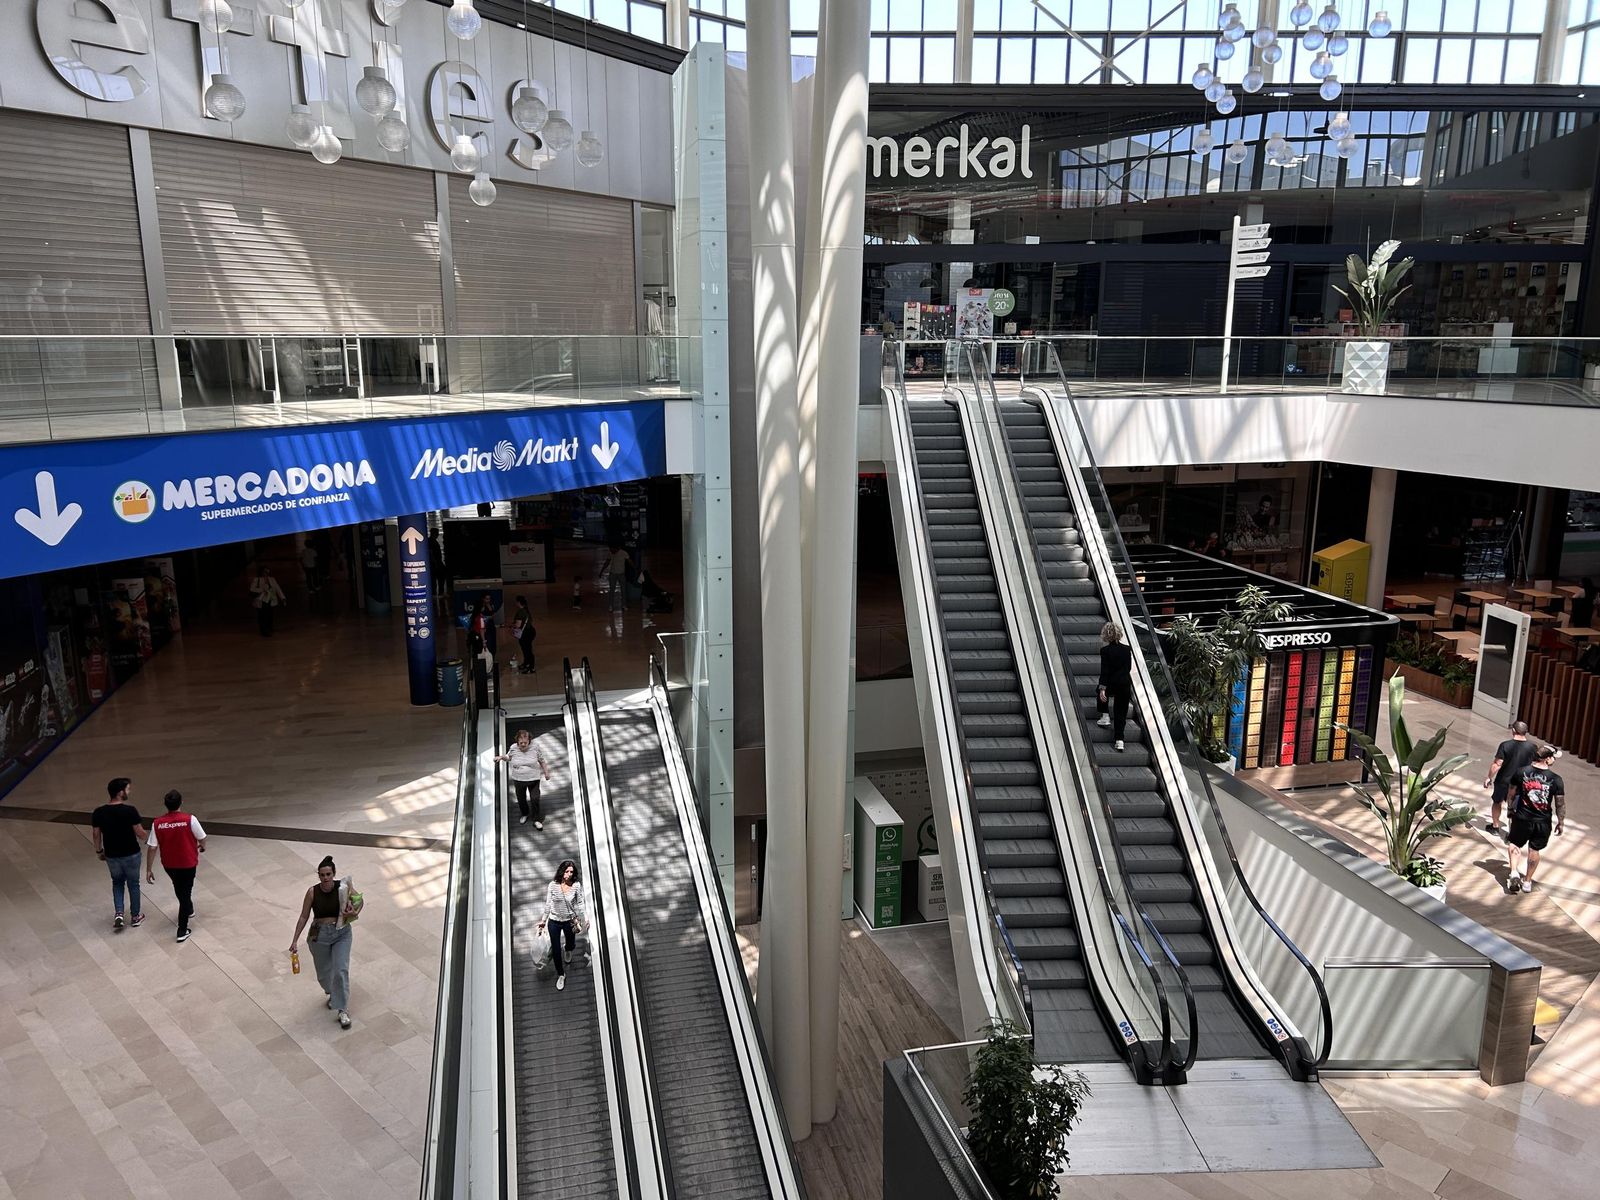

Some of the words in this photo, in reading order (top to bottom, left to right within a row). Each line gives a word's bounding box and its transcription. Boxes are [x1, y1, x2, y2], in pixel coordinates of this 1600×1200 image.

[864, 122, 1034, 179] merkal
[410, 447, 492, 480] Media
[515, 437, 579, 468] Markt
[162, 459, 377, 511] MERCADONA
[201, 502, 283, 521] SUPERMERCADOS
[285, 500, 297, 509] DE
[299, 492, 350, 507] CONFIANZA
[1256, 632, 1331, 650] NESPRESSO
